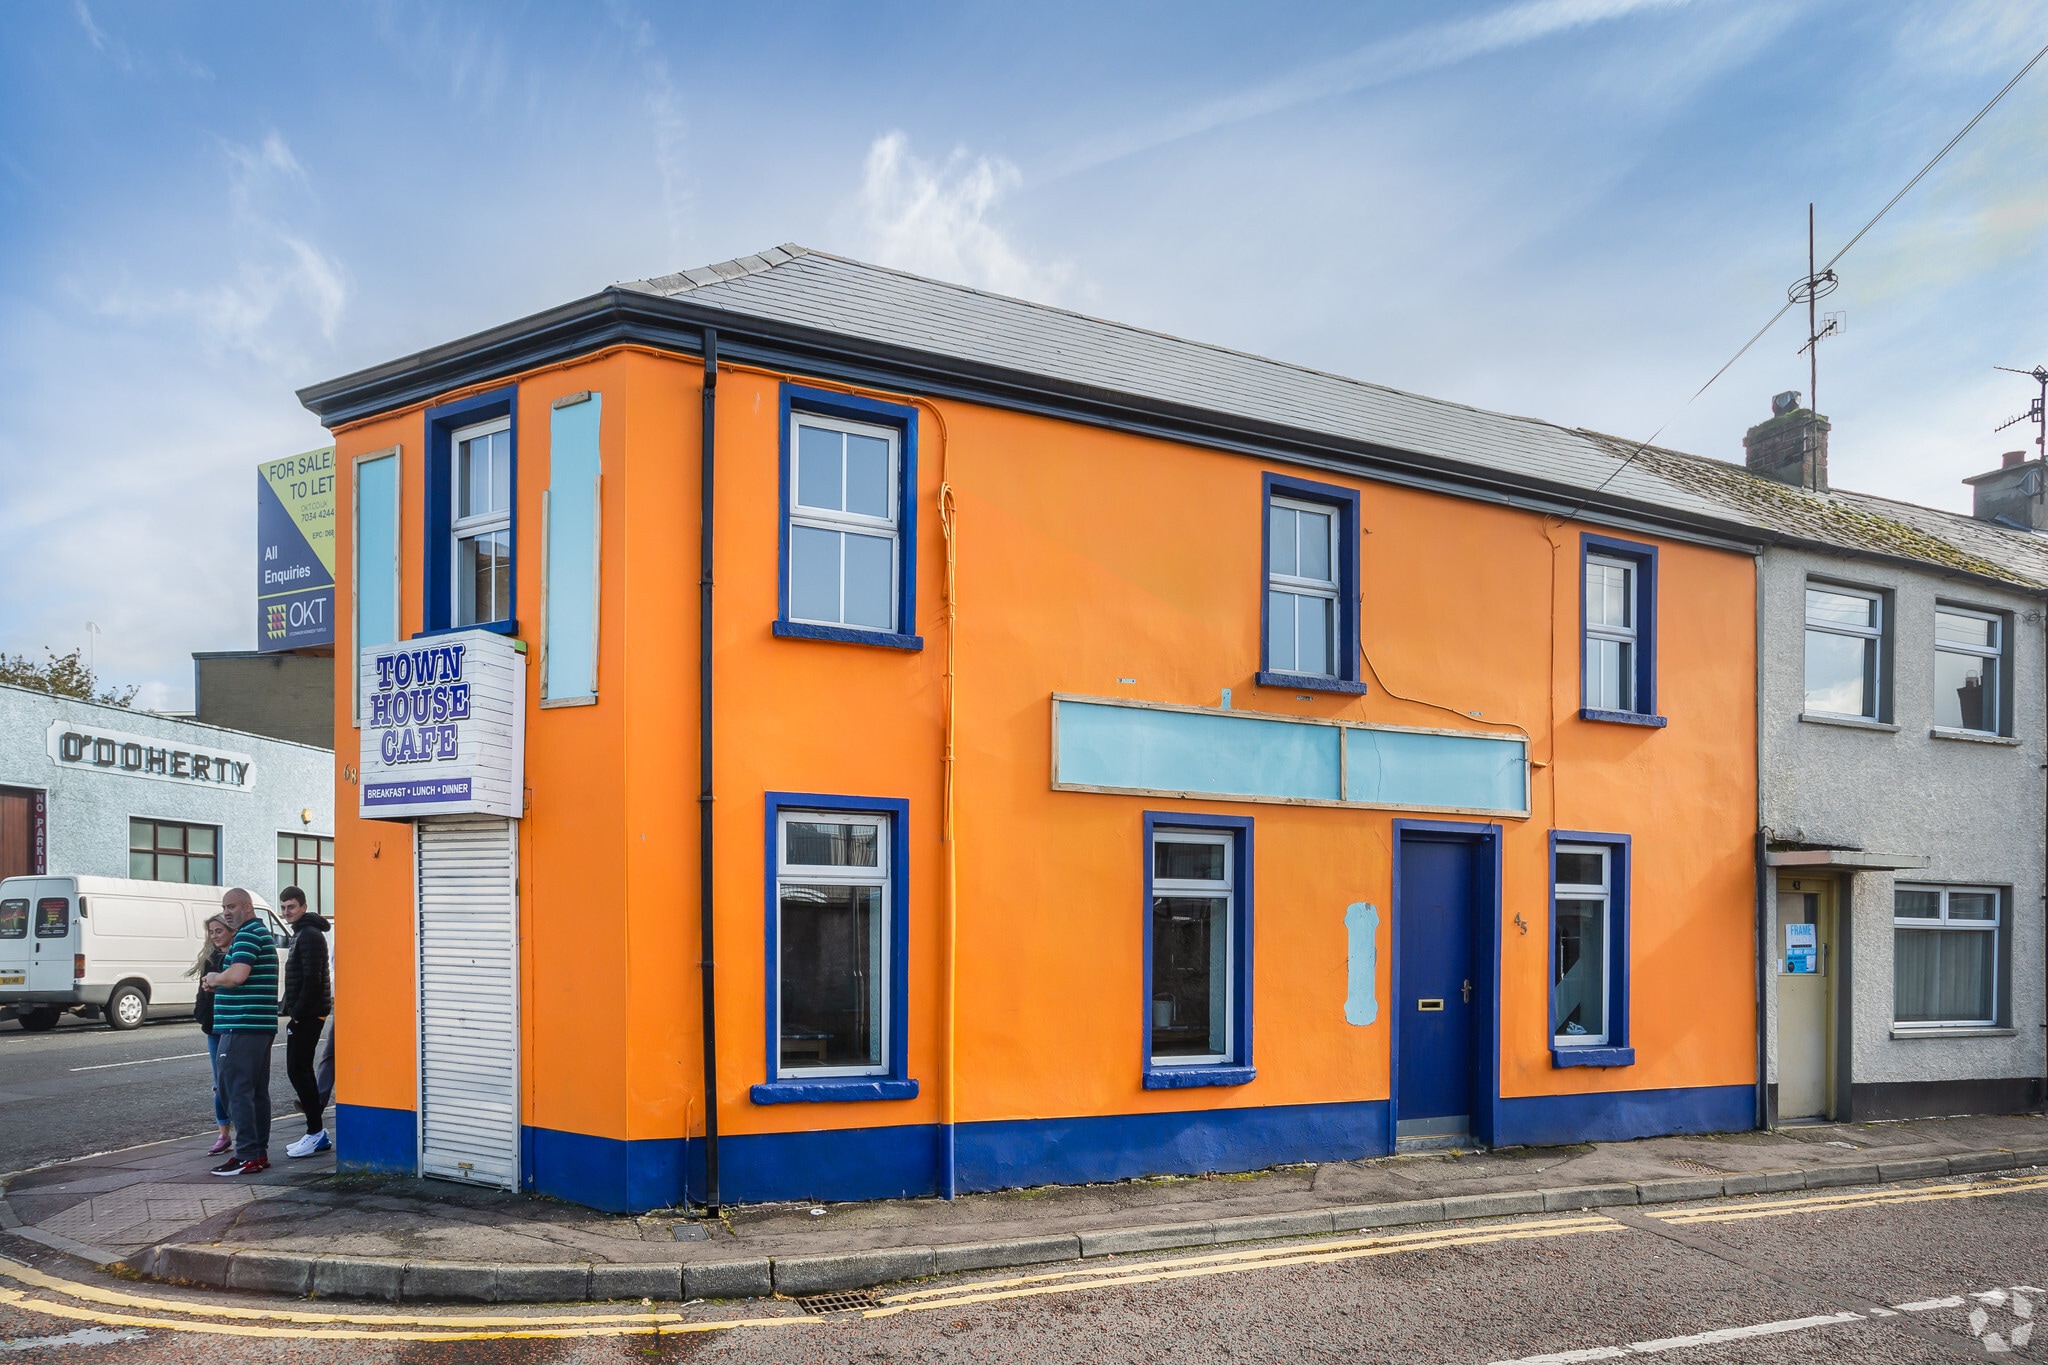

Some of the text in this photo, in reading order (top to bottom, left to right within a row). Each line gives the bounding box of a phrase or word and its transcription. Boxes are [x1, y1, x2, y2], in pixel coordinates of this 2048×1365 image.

[269, 450, 335, 481] FOR SALE/
[290, 475, 334, 499] TO LET
[301, 508, 334, 522] 7034 4244
[265, 545, 278, 561] All
[264, 564, 311, 584] Enquiries
[289, 598, 327, 627] OKT
[375, 644, 465, 690] TOWN
[369, 683, 470, 728] HOUSE
[381, 723, 458, 765] CAFE
[62, 731, 250, 786] O'DOHERTY
[343, 763, 358, 785] 68
[36, 794, 44, 812] NO
[367, 783, 469, 799] BREAKFAST LUNCH DINNER
[1514, 911, 1528, 936] 45
[1790, 925, 1812, 936] FRAME
